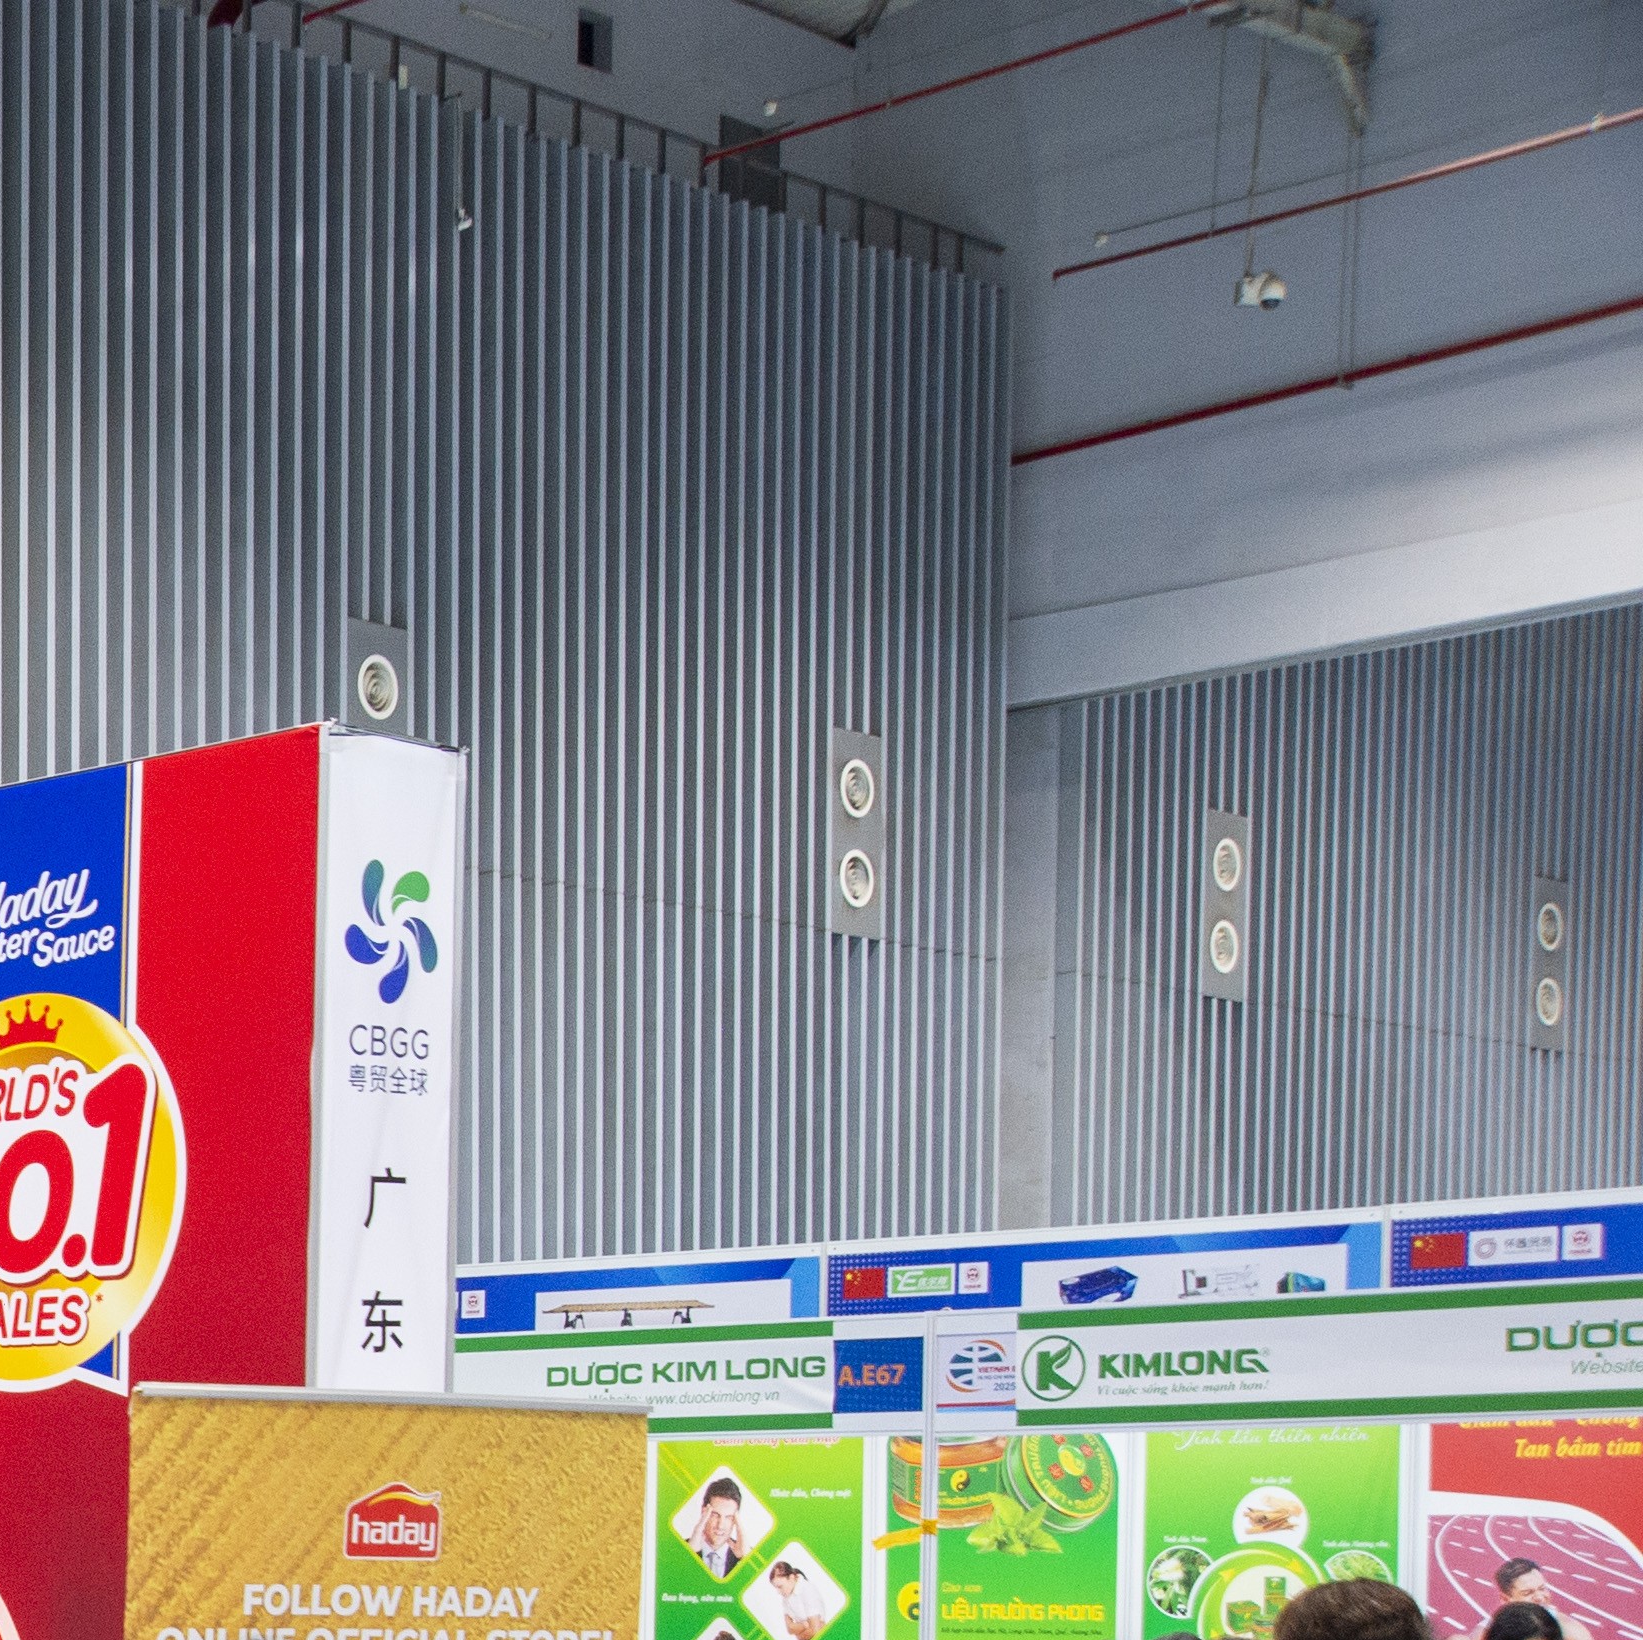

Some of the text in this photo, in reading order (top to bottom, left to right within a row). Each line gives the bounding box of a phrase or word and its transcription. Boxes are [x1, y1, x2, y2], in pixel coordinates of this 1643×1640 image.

[32, 924, 115, 967] Sauce
[349, 1024, 430, 1061] CBGG
[349, 1064, 429, 1097] 粤贸全球
[362, 1167, 407, 1354] 广东
[546, 1356, 826, 1392] DƯỢC KIM LONG
[838, 1364, 907, 1386] A.E67
[1099, 1348, 1270, 1379] KIMLONG
[1515, 1439, 1550, 1458] Tan
[351, 1514, 437, 1552] haday
[243, 1584, 538, 1618] FOLLOW HADAY
[941, 1597, 1104, 1622] LIỆU TRƯỜNG PHONG
